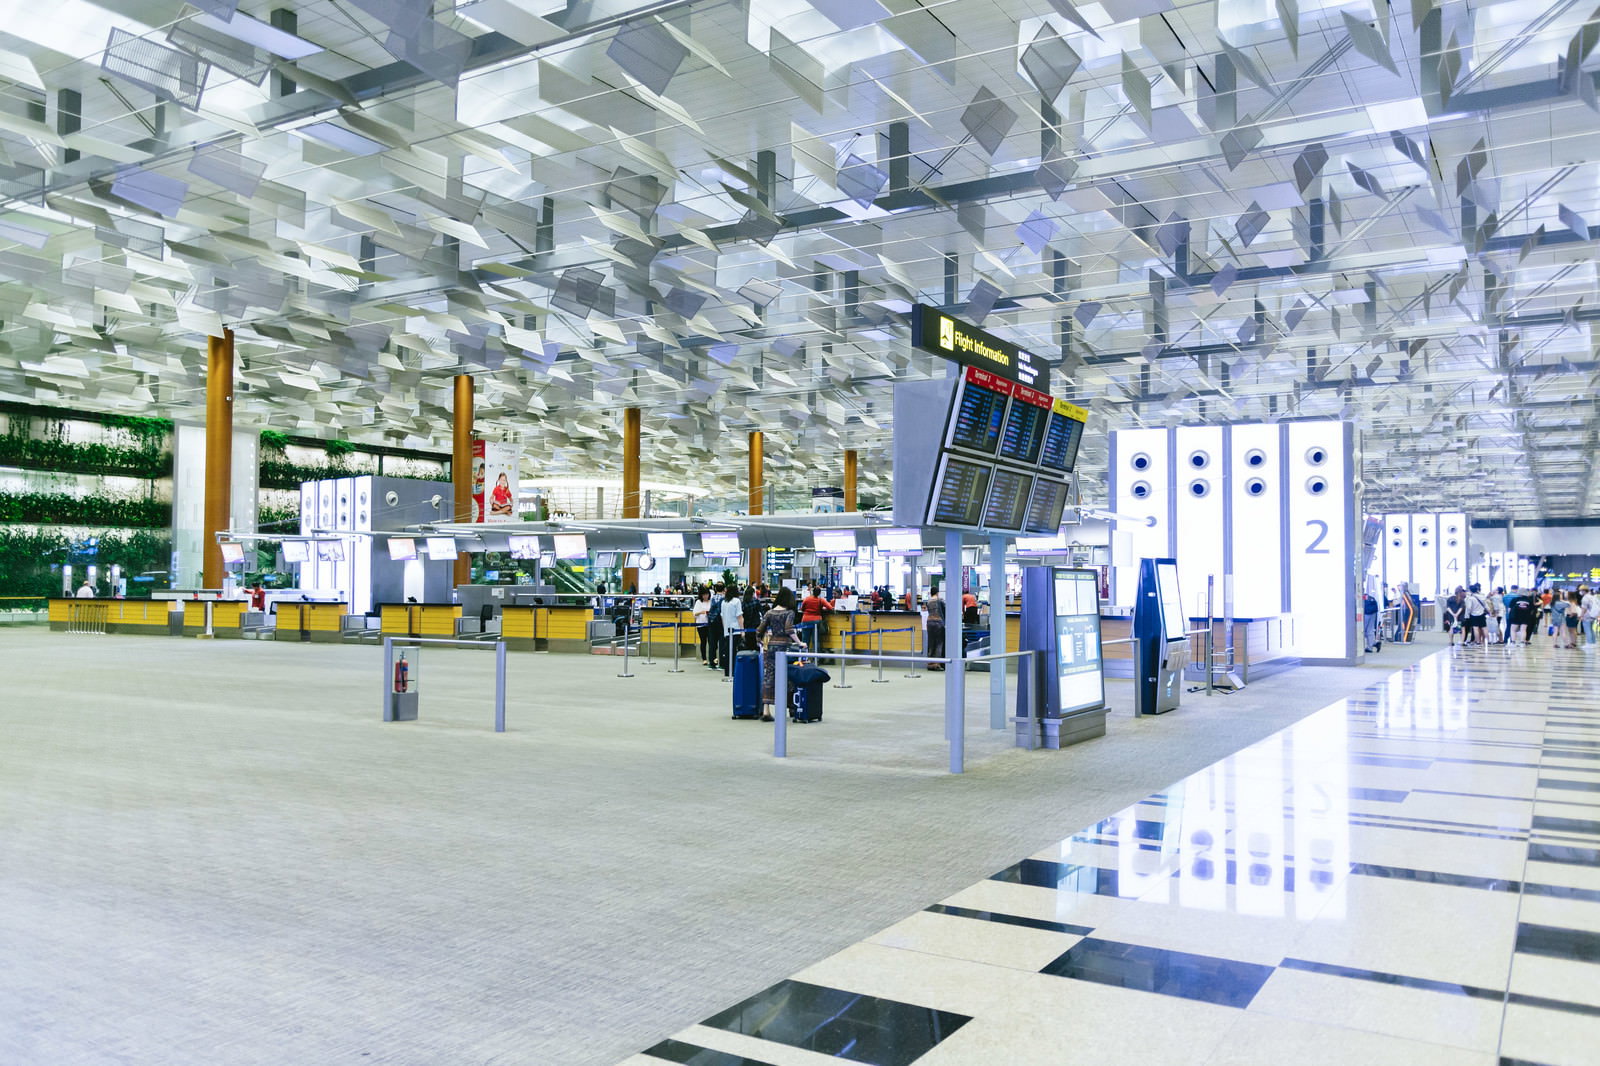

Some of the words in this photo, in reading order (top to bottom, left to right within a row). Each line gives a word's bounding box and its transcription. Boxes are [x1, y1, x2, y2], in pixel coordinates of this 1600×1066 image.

[954, 331, 973, 352] Flight
[974, 340, 1009, 366] Information
[1305, 519, 1330, 554] 2
[1446, 557, 1459, 573] 4
